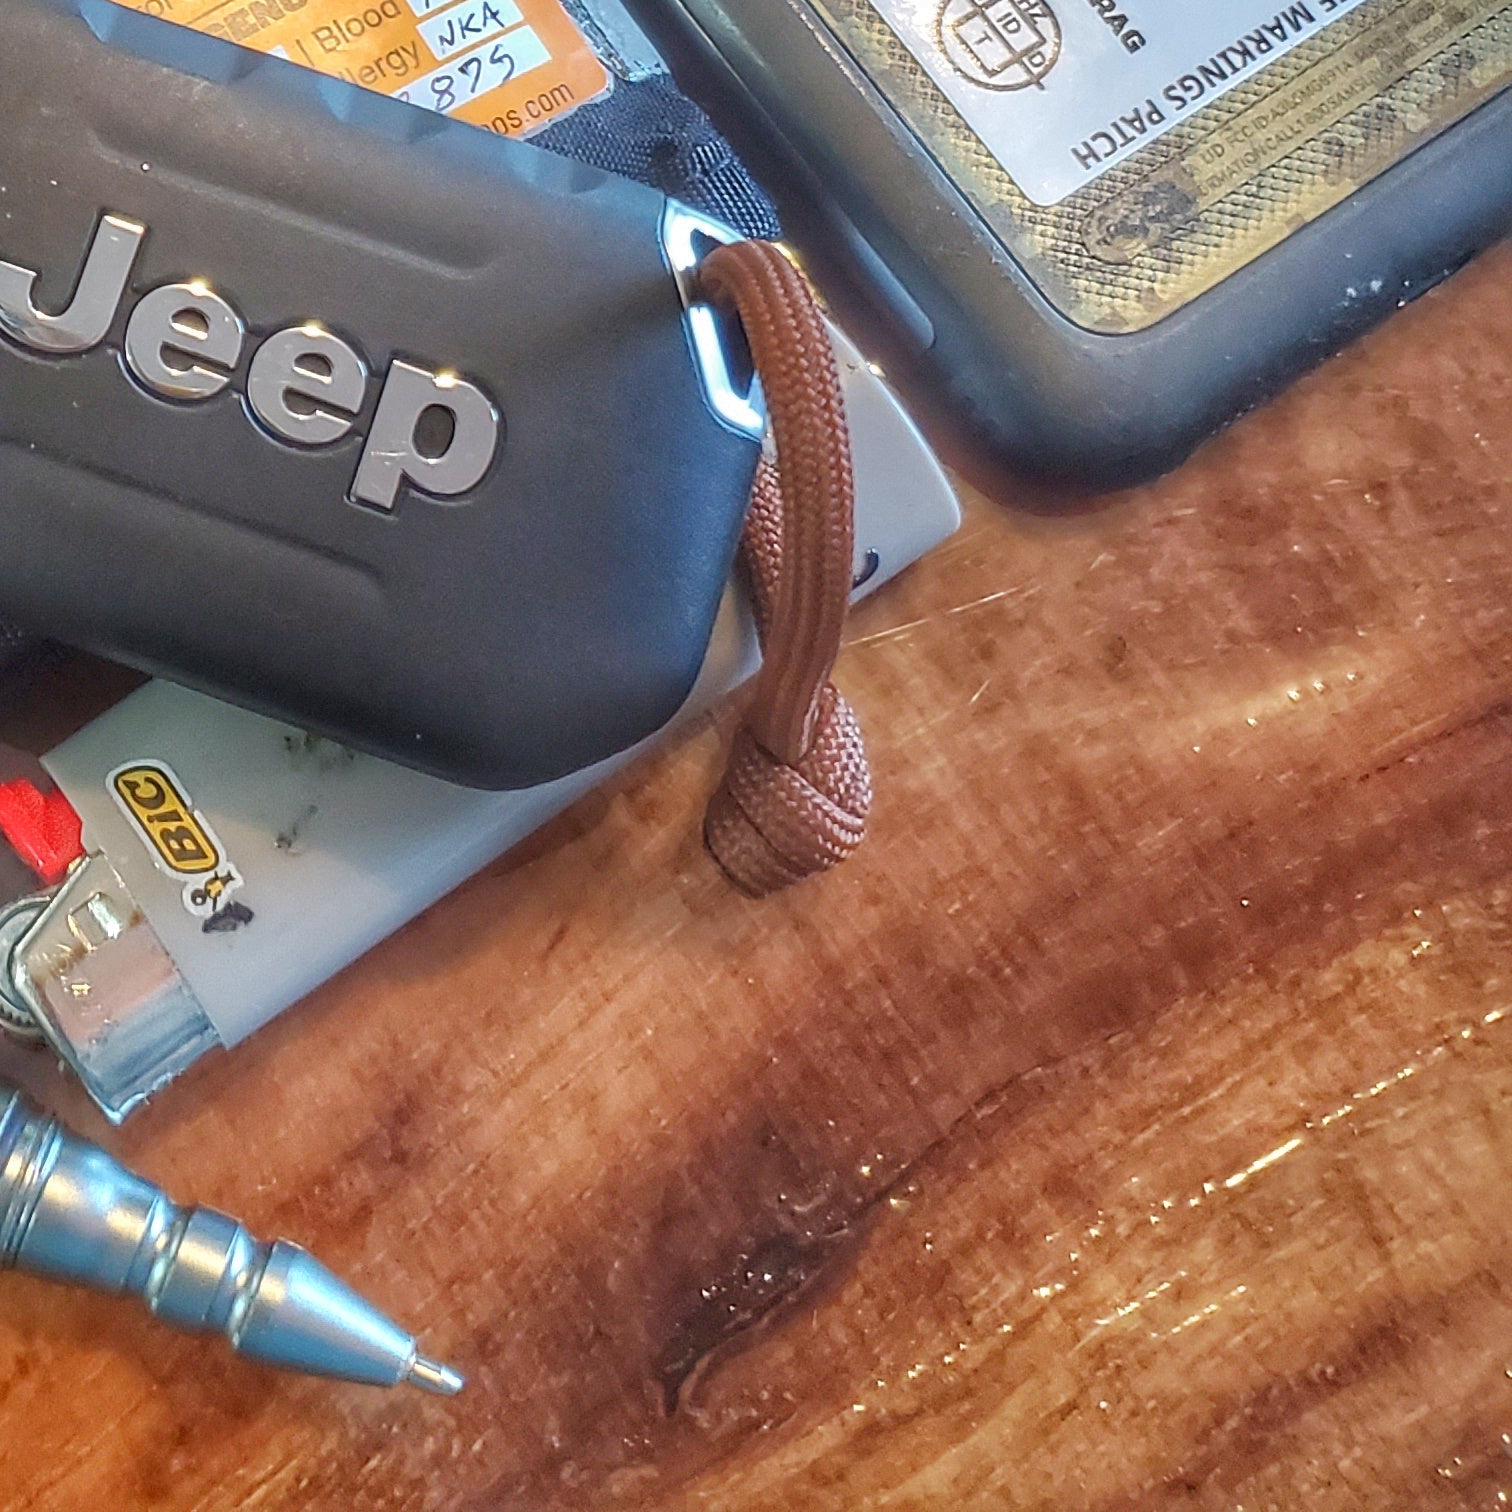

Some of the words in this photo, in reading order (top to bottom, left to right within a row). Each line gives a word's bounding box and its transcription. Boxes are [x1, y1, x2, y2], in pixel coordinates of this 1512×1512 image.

[997, 12, 1021, 34] ID
[1164, 0, 1317, 111] MARKINGS
[339, 41, 420, 86] lergy
[1071, 98, 1166, 172] PATCH
[123, 777, 207, 863] BIC
